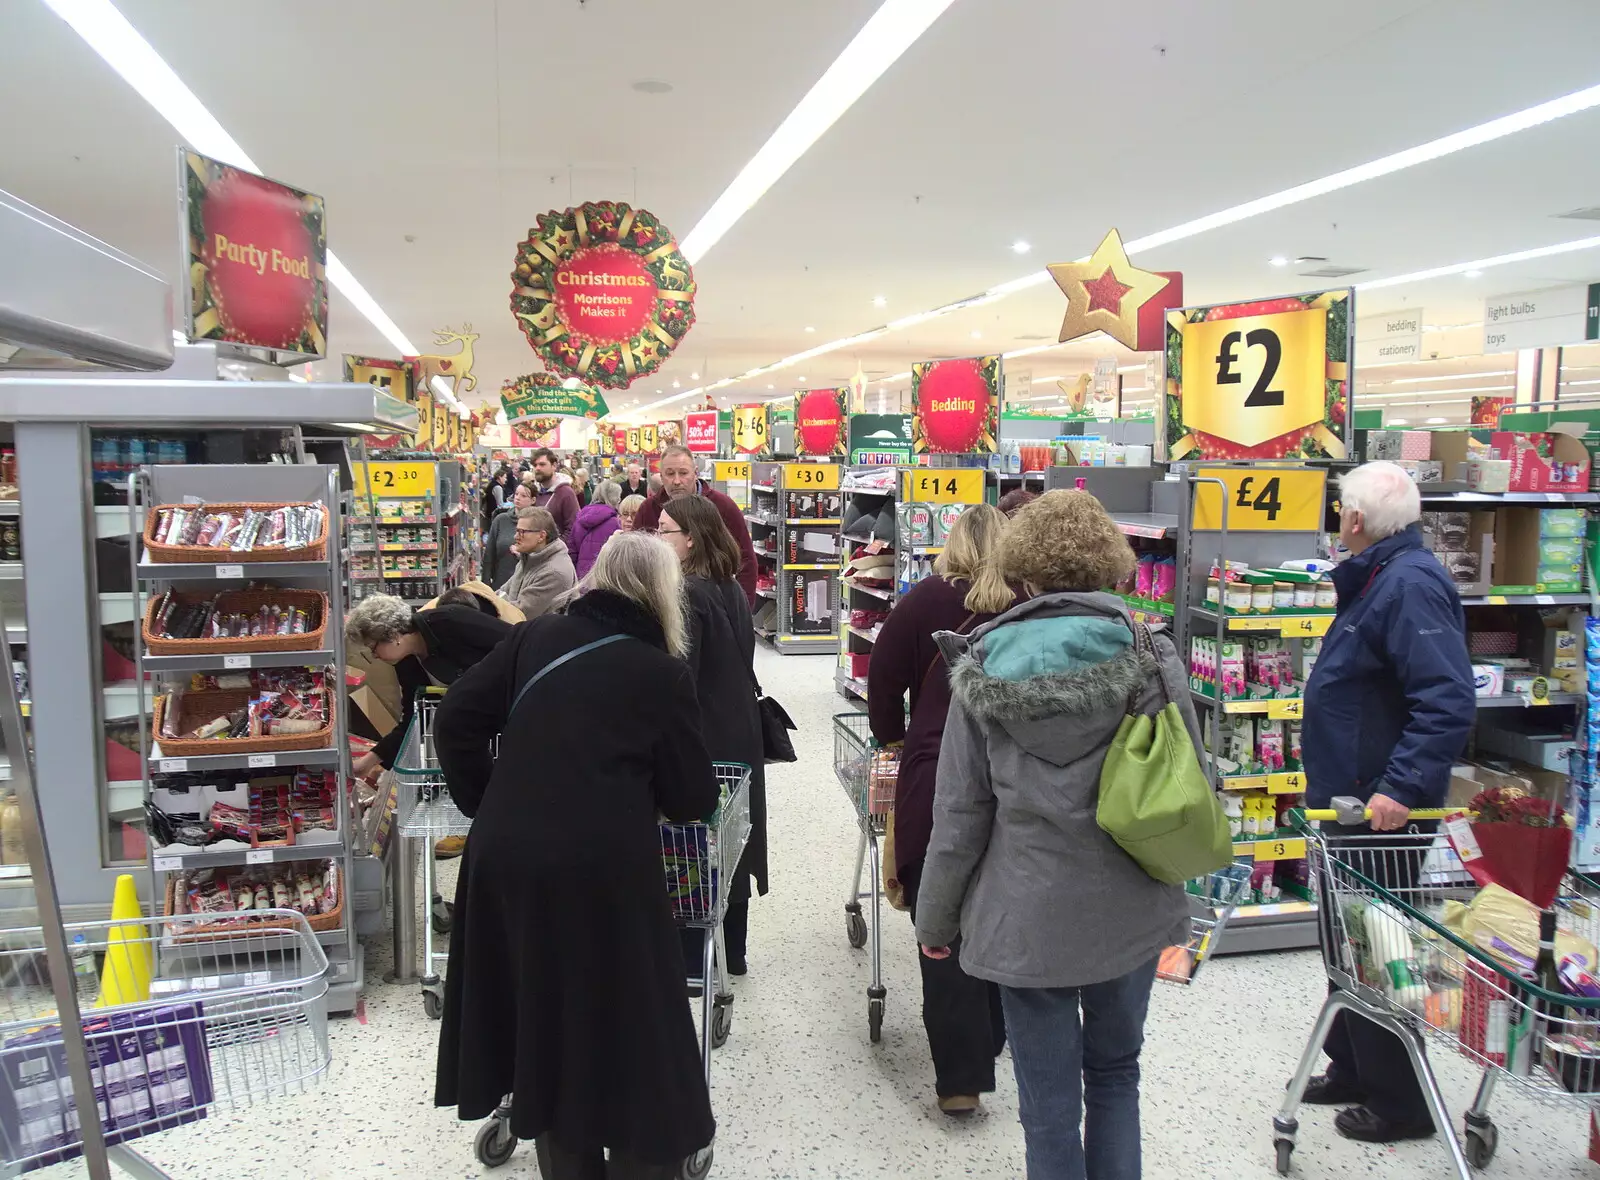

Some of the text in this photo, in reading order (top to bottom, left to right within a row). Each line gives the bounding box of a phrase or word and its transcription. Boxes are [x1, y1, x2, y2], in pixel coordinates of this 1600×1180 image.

[214, 233, 309, 279] Party Food
[573, 293, 633, 304] Morrisons
[580, 306, 627, 317] Makes it
[1487, 301, 1536, 321] light bulbs
[1587, 306, 1599, 318] 11
[1386, 319, 1417, 332] bedding
[1487, 333, 1506, 347] toys
[1378, 344, 1416, 356] stationery
[1215, 328, 1285, 408] £2
[930, 398, 975, 414] Bedding
[802, 418, 837, 427] Kitchenware
[688, 425, 715, 437] 50% off
[921, 478, 957, 495] £14
[1236, 476, 1282, 521] £4
[911, 514, 928, 524] AIRY
[789, 530, 797, 563] warmlite
[794, 574, 804, 613] warmlite
[1300, 620, 1312, 632] £4
[1286, 776, 1298, 788] £4
[1274, 843, 1285, 855] £3
